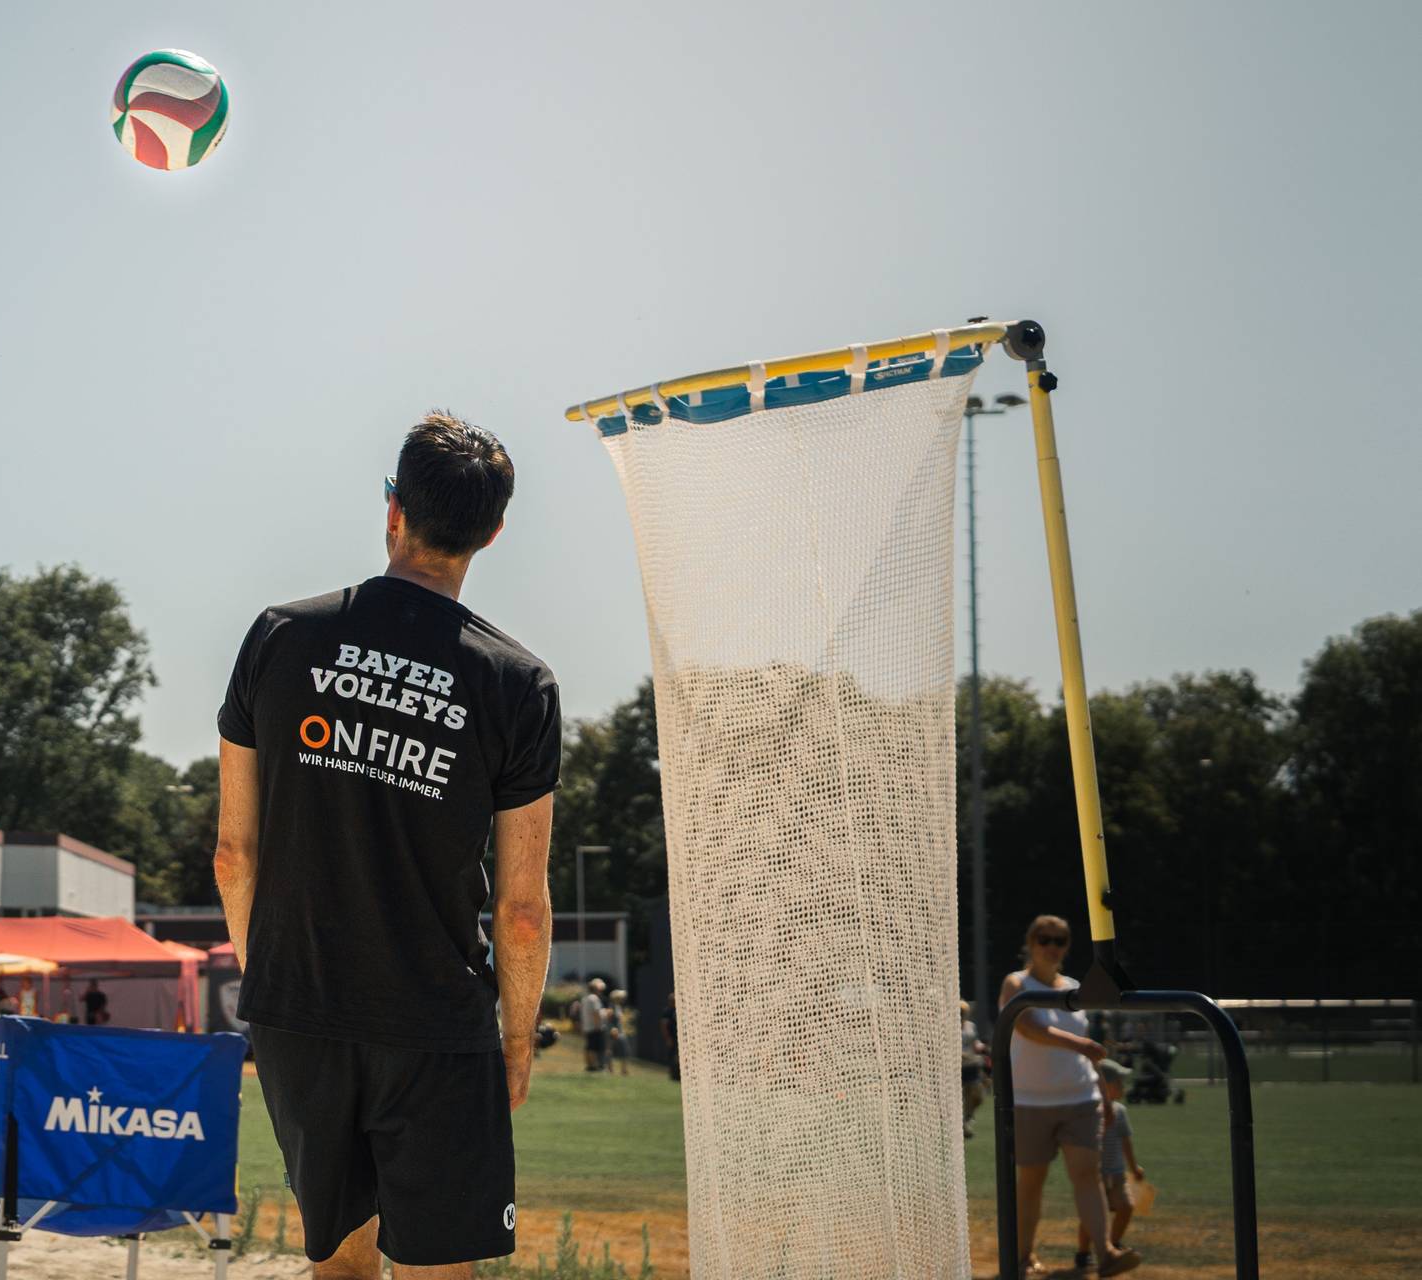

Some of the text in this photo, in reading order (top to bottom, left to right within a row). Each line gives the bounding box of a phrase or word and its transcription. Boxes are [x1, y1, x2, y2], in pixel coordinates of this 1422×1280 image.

[311, 667, 467, 730] VOLLEYS
[335, 644, 454, 696] BAYER
[299, 752, 322, 766] WIR
[325, 756, 365, 774] HABEN
[300, 715, 457, 784] ON FIRE
